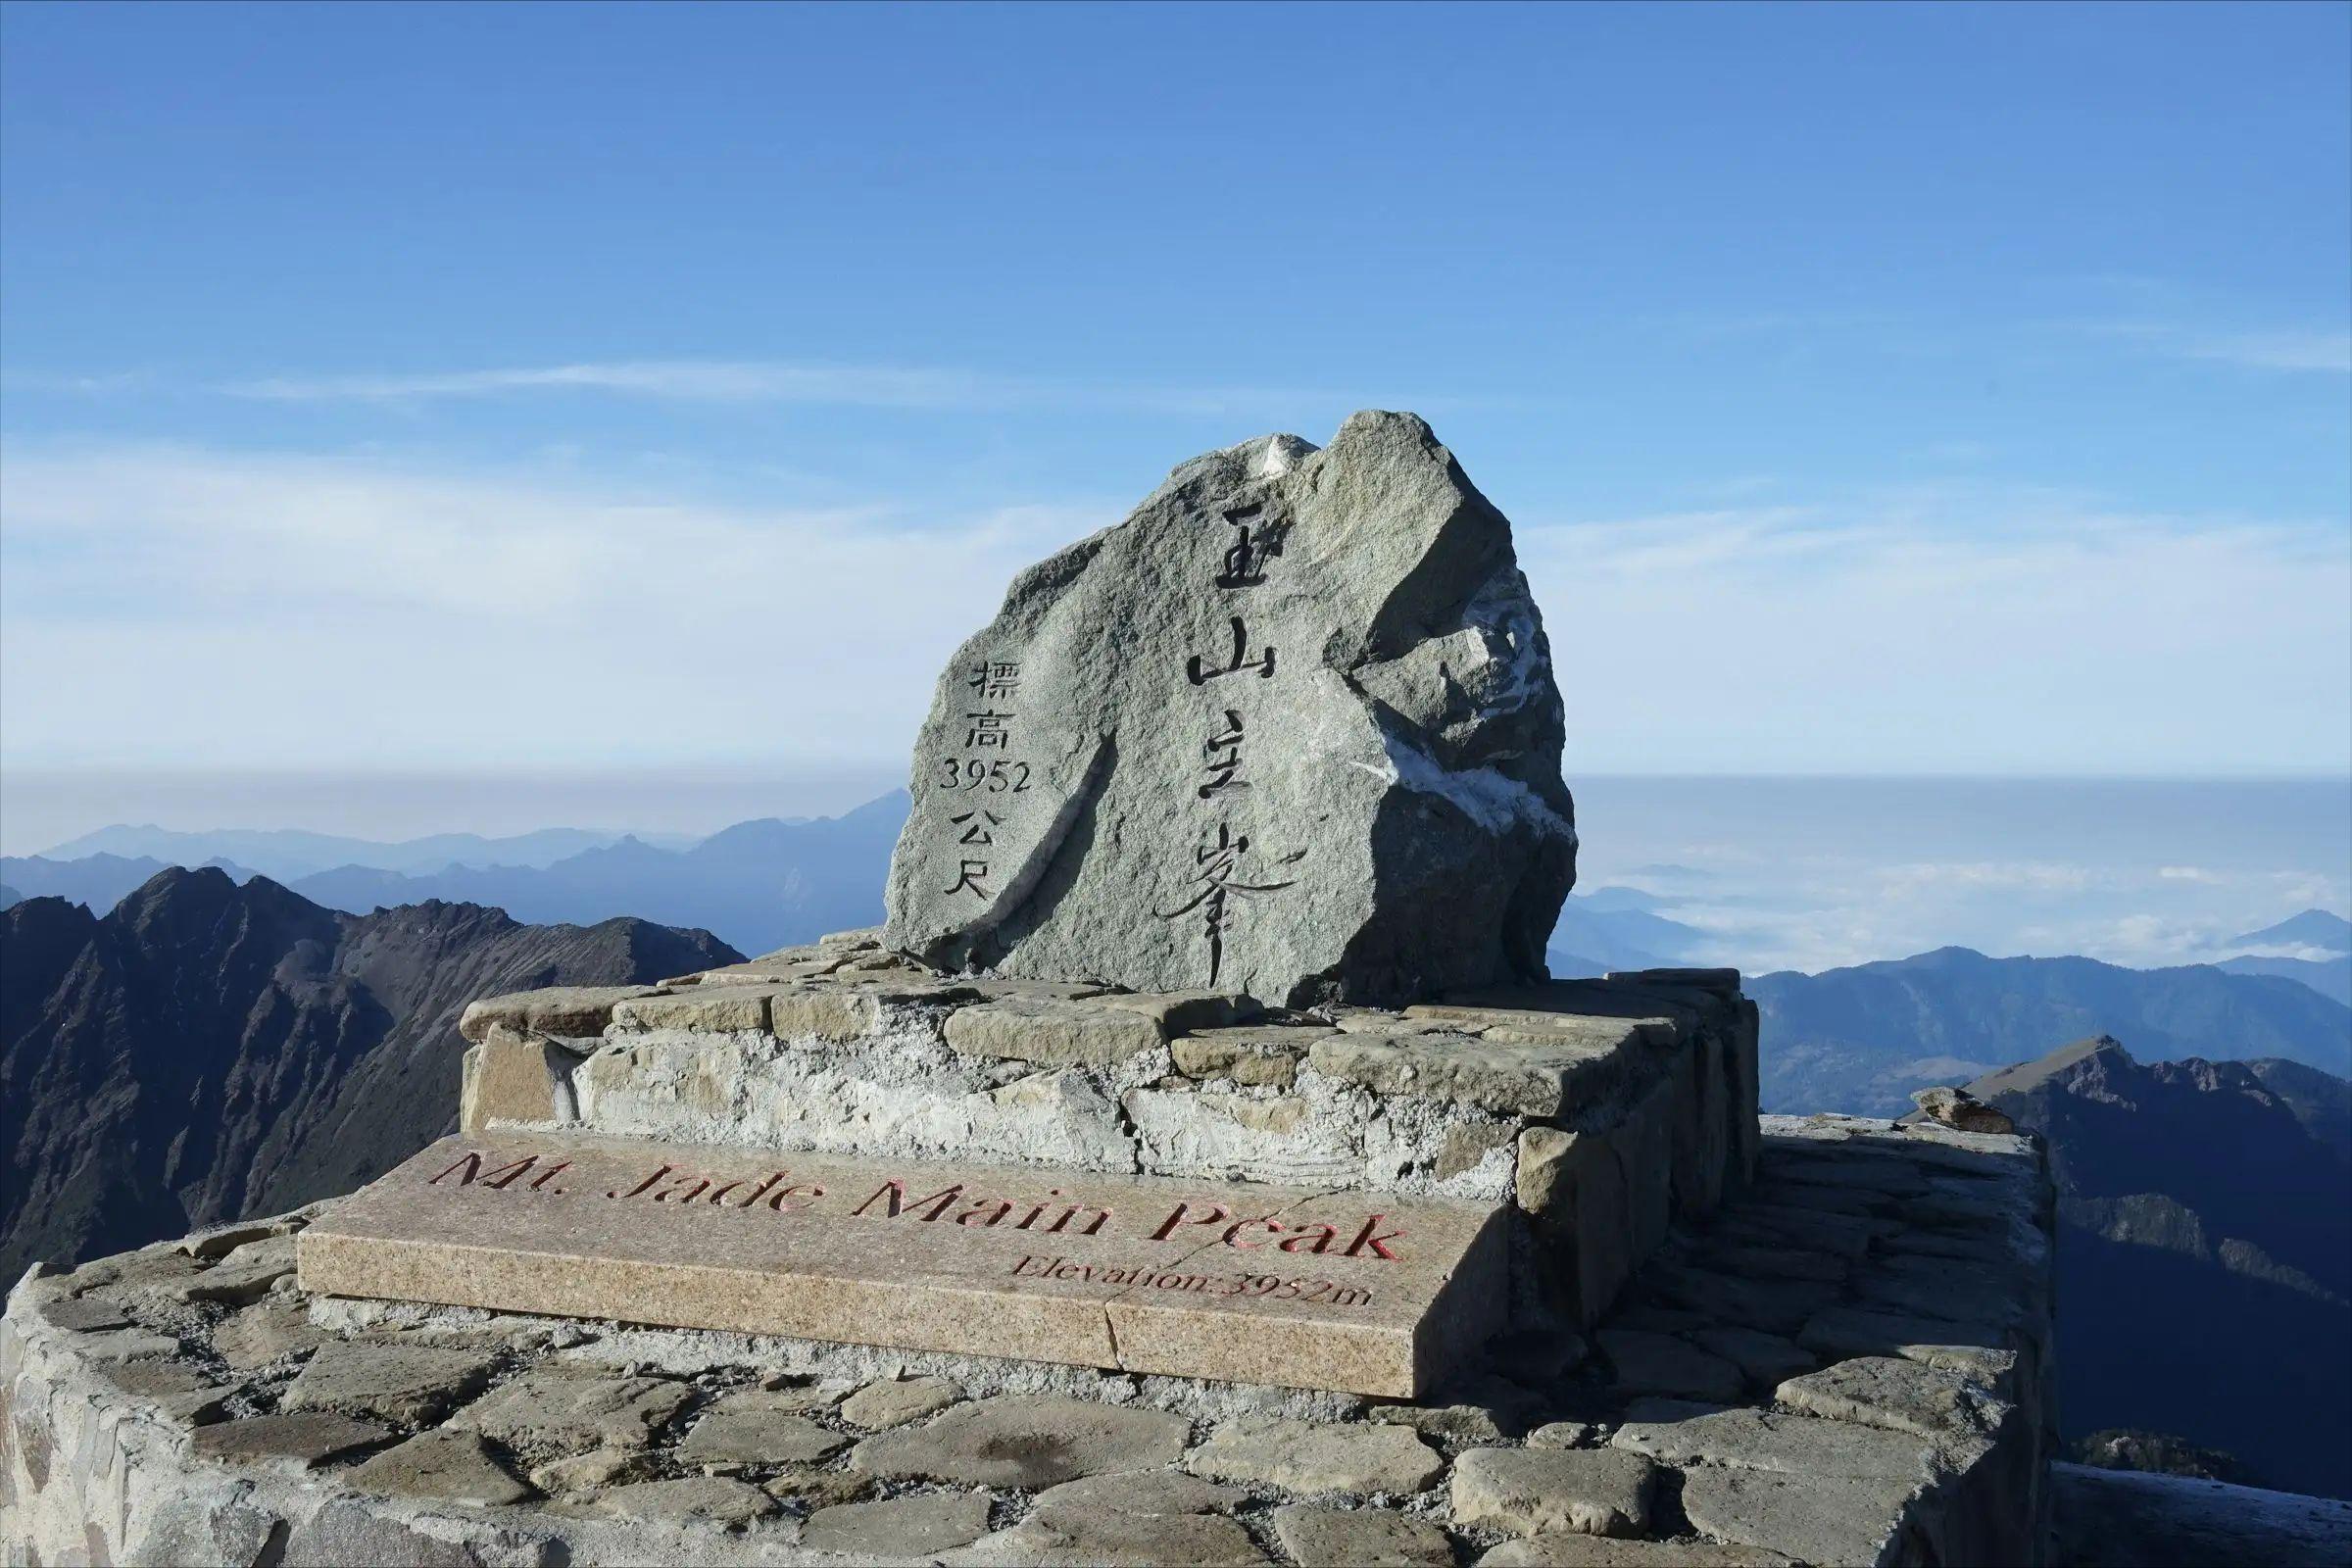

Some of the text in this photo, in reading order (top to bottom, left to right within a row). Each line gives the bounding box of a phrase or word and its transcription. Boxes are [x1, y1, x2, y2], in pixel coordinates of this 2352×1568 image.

[428, 1152, 1407, 1262] Mt. Jade Main Peak
